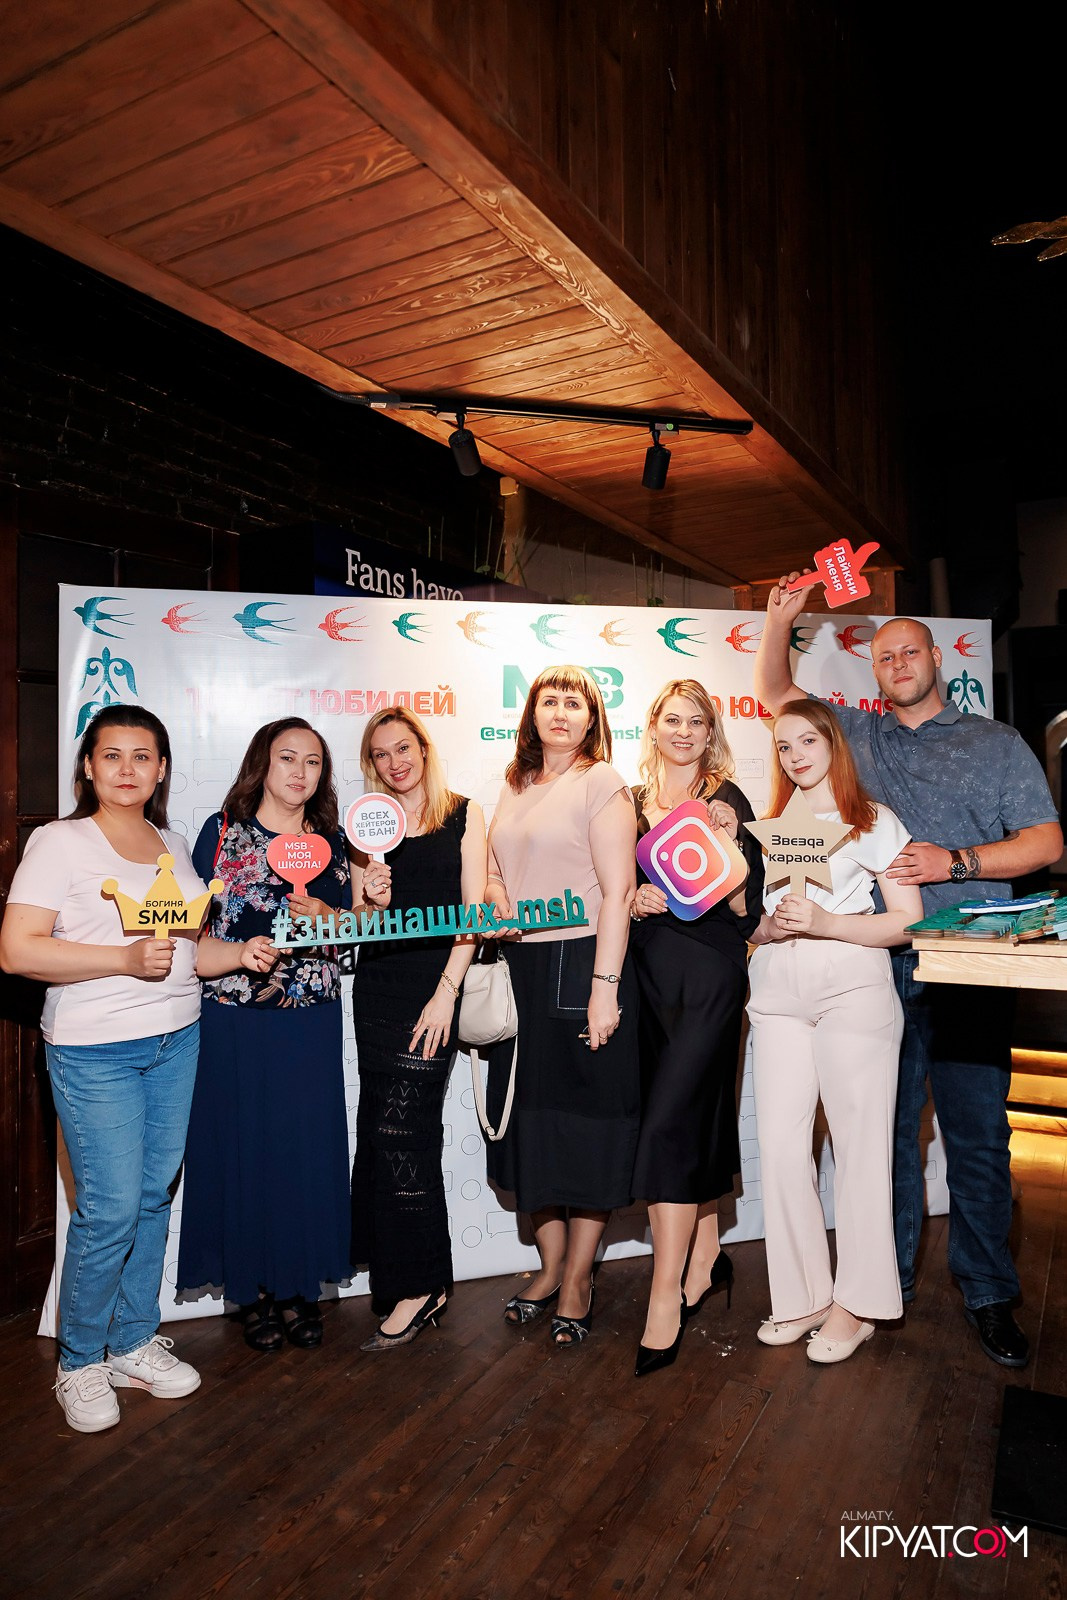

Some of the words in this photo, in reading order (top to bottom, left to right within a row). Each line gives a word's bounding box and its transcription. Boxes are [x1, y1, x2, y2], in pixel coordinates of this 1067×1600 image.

[345, 548, 405, 599] Fans
[825, 558, 843, 591] меня
[834, 546, 858, 595] Лайкни
[361, 811, 390, 821] ВСЕХ
[355, 820, 396, 829] ХЕЙТЕРОВ
[358, 829, 366, 838] В
[369, 827, 395, 837] БАН!
[285, 842, 308, 851] MSB
[771, 834, 825, 849] Звезда
[287, 851, 312, 860] МОЯ
[768, 853, 828, 865] караоке
[277, 860, 321, 869] ШКОЛА!
[145, 900, 184, 908] БОГИНЯ
[138, 909, 188, 925] SMM
